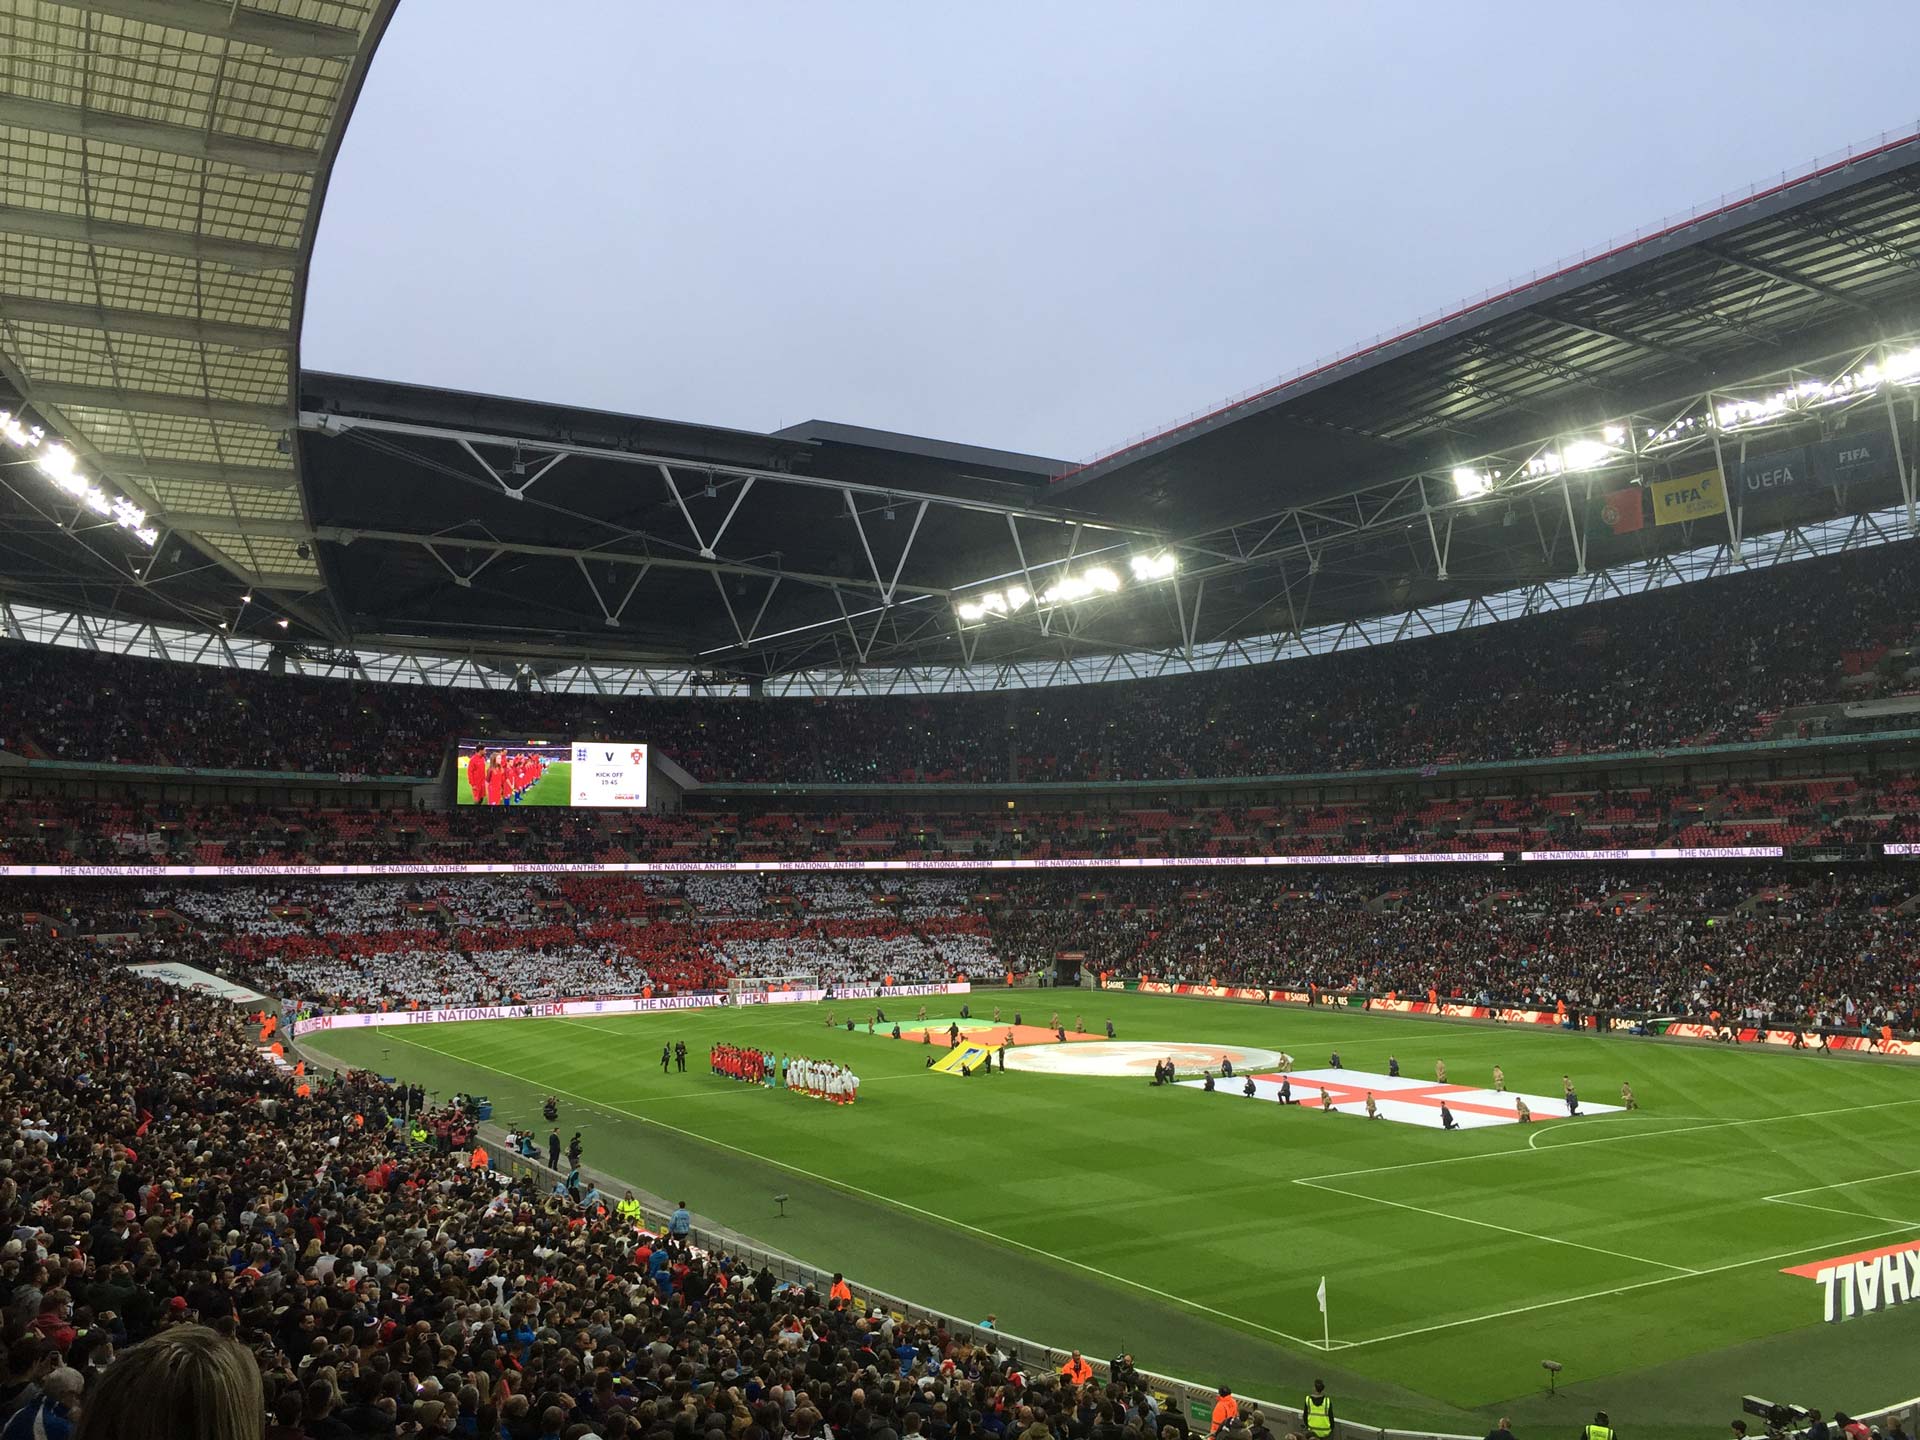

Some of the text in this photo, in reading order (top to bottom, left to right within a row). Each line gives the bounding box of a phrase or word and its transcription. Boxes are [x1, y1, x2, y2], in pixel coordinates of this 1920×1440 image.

[1839, 447, 1870, 463] FIFA
[1747, 467, 1794, 490] UEFA
[1664, 487, 1701, 507] FIFA
[605, 752, 614, 762] V
[1532, 850, 1629, 859] THE NATIONAL ANTHEM
[1679, 849, 1697, 857] THE
[1699, 848, 1748, 857] NATIONAL
[1161, 858, 1176, 866] THE
[1216, 858, 1247, 866] ANTHEM
[1301, 856, 1336, 864] NATIONAL
[1337, 855, 1366, 863] ANTHEM
[1404, 853, 1489, 862] THE NATIONAL ANTHEM
[512, 863, 605, 872] THE NATIONAL ANTHEM
[648, 863, 663, 871] THE
[665, 863, 702, 871] NATIONAL
[778, 862, 793, 870] THE
[832, 861, 865, 869] ANTHEM
[1050, 859, 1086, 867] NATIONAL
[1089, 859, 1121, 867] ANTHEM
[59, 866, 166, 875] THE NATIONAL ANTHEM
[218, 866, 321, 874] THE NATIONAL ANTHEM
[370, 864, 467, 873] THE NATIONAL ANTHEM
[906, 984, 949, 996] ANTHEM
[634, 998, 657, 1010] THE
[660, 995, 716, 1009] NATIONAL
[406, 1012, 433, 1023] THE
[437, 1008, 504, 1022] NATIONAL
